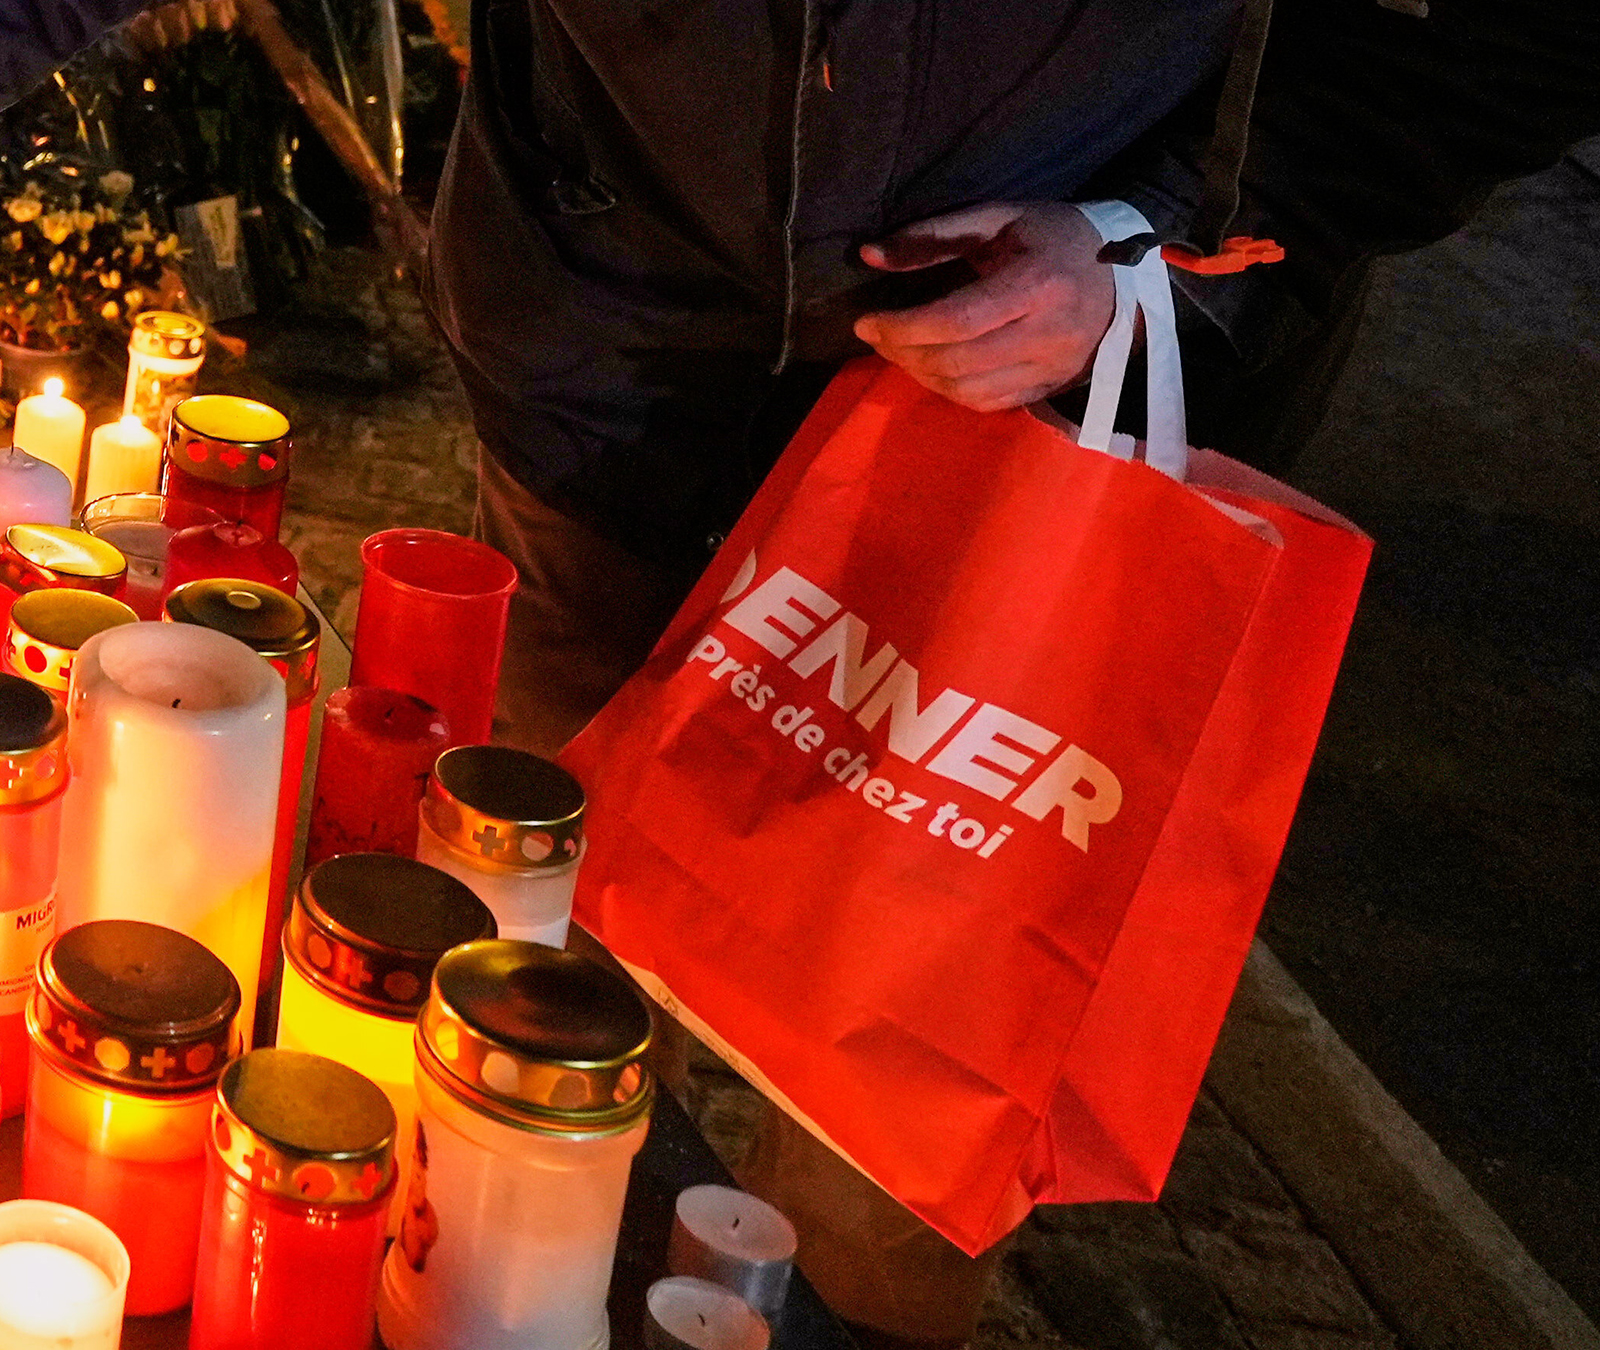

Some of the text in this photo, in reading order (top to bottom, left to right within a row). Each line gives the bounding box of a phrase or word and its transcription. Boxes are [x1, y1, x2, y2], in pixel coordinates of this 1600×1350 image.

[687, 634, 1015, 860] Près de chez toi
